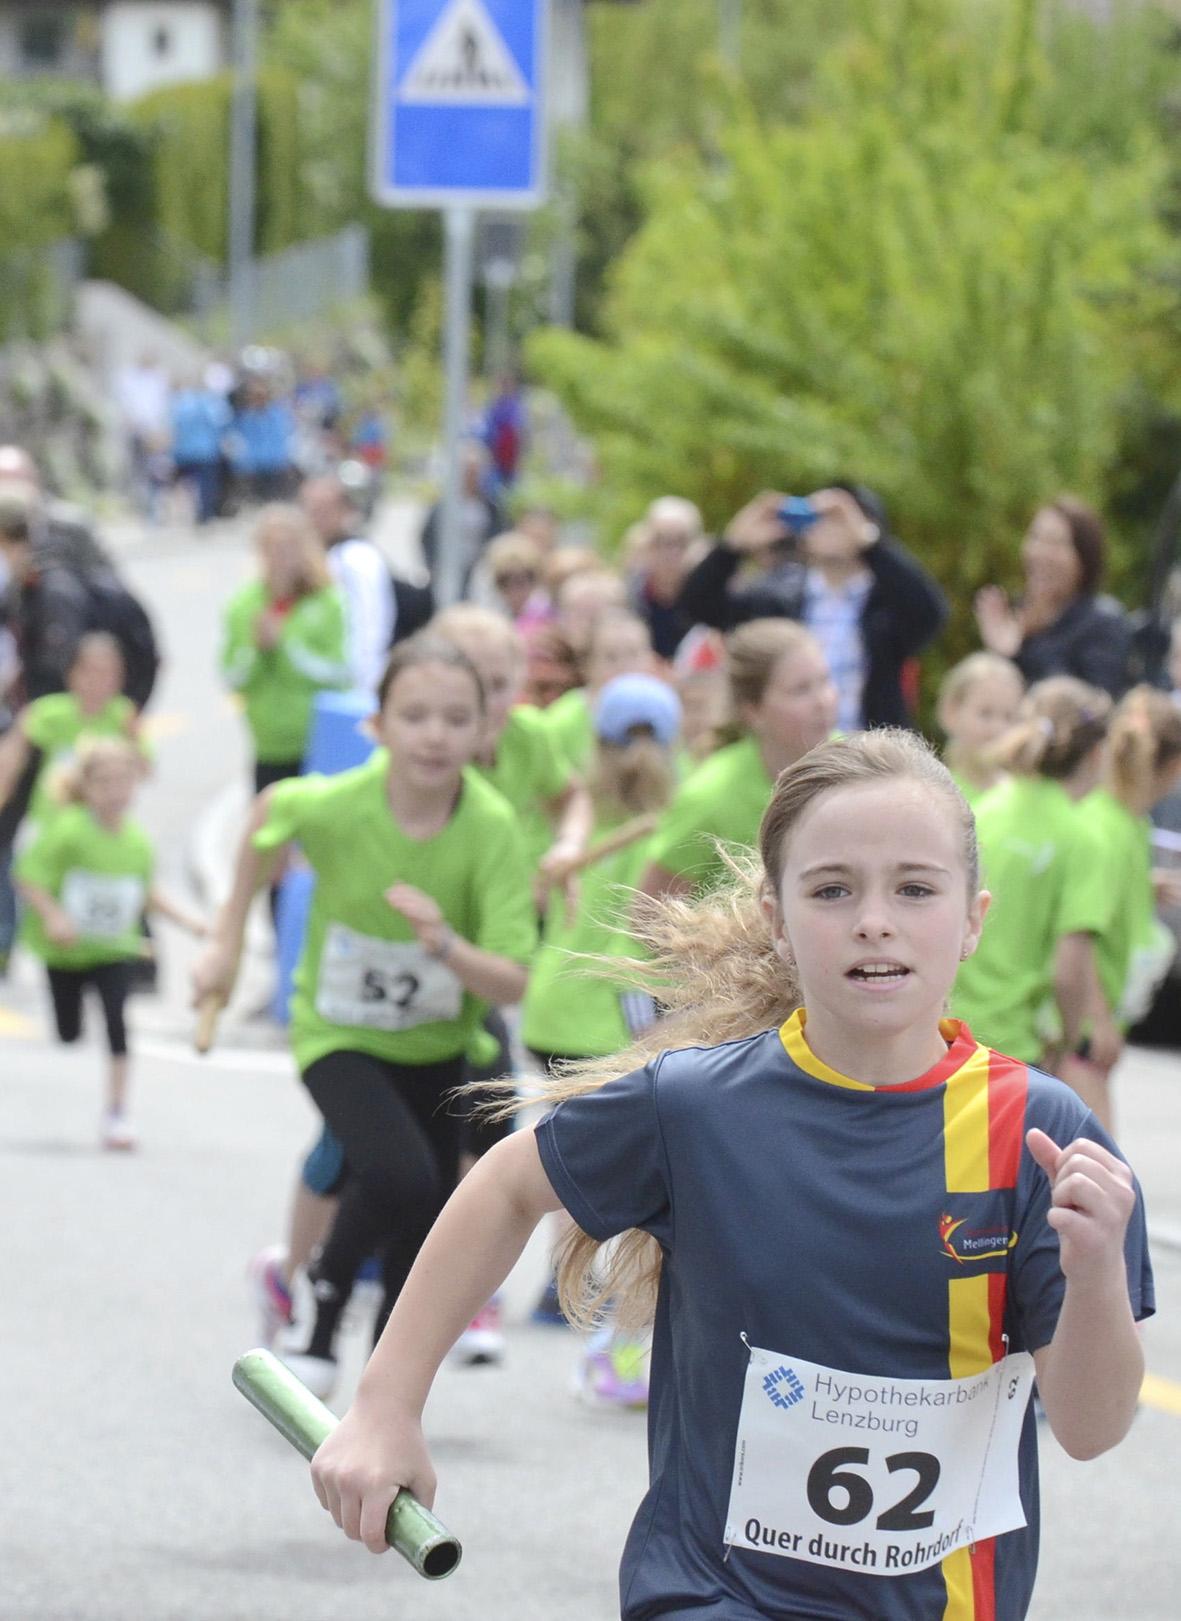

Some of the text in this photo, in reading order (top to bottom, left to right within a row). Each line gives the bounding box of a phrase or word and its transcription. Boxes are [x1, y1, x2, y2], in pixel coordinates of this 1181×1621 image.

[811, 1402, 919, 1437] Lenzburg
[807, 1446, 941, 1531] 62
[745, 1518, 965, 1568] Quer durch Rohrdorf
